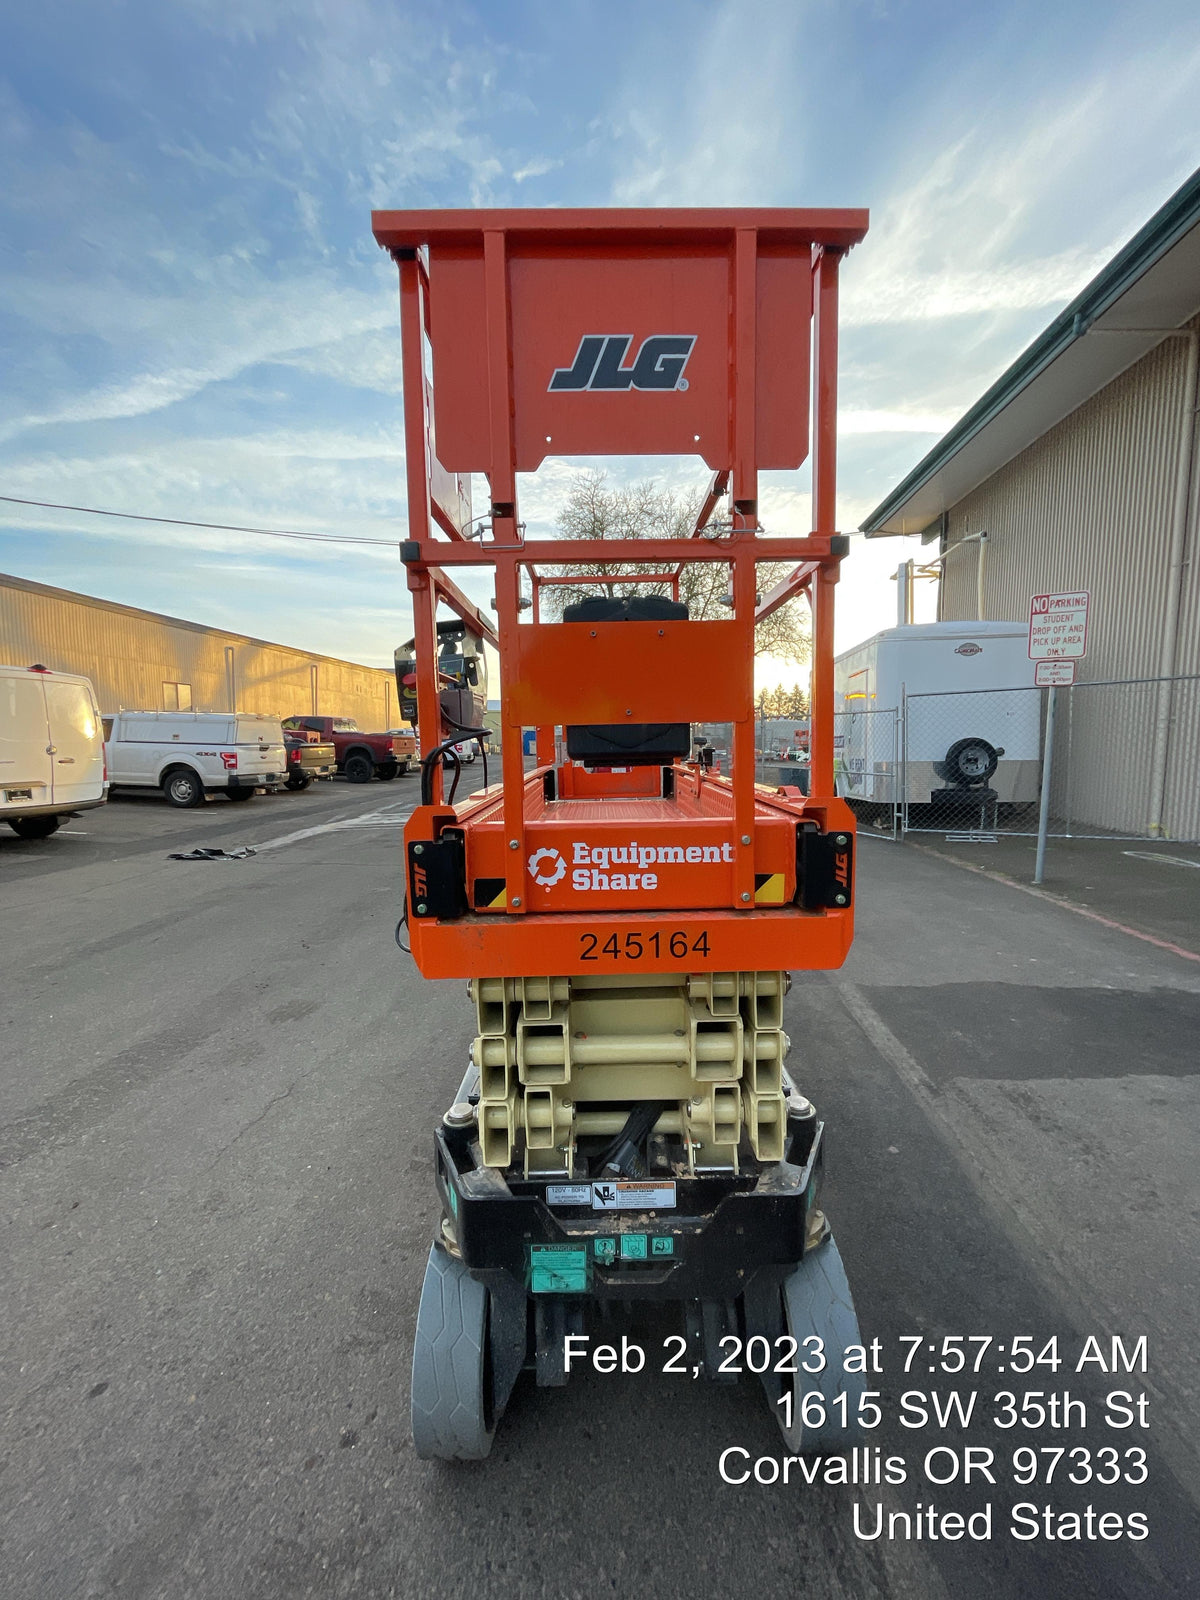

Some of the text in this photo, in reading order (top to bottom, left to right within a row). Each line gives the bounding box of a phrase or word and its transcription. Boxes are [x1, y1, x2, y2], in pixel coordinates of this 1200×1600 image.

[547, 334, 698, 392] JLG
[1033, 597, 1087, 613] NO PARKING
[1032, 624, 1084, 636] DROP OFF AND
[1044, 614, 1075, 624] STUDENT
[1033, 635, 1082, 646] PICK UP AREA
[1047, 648, 1066, 656] ONLY
[572, 842, 734, 869] Equipment
[413, 863, 428, 898] JLG
[572, 869, 658, 891] Share
[835, 853, 848, 888] JLG
[580, 931, 711, 960] 245164
